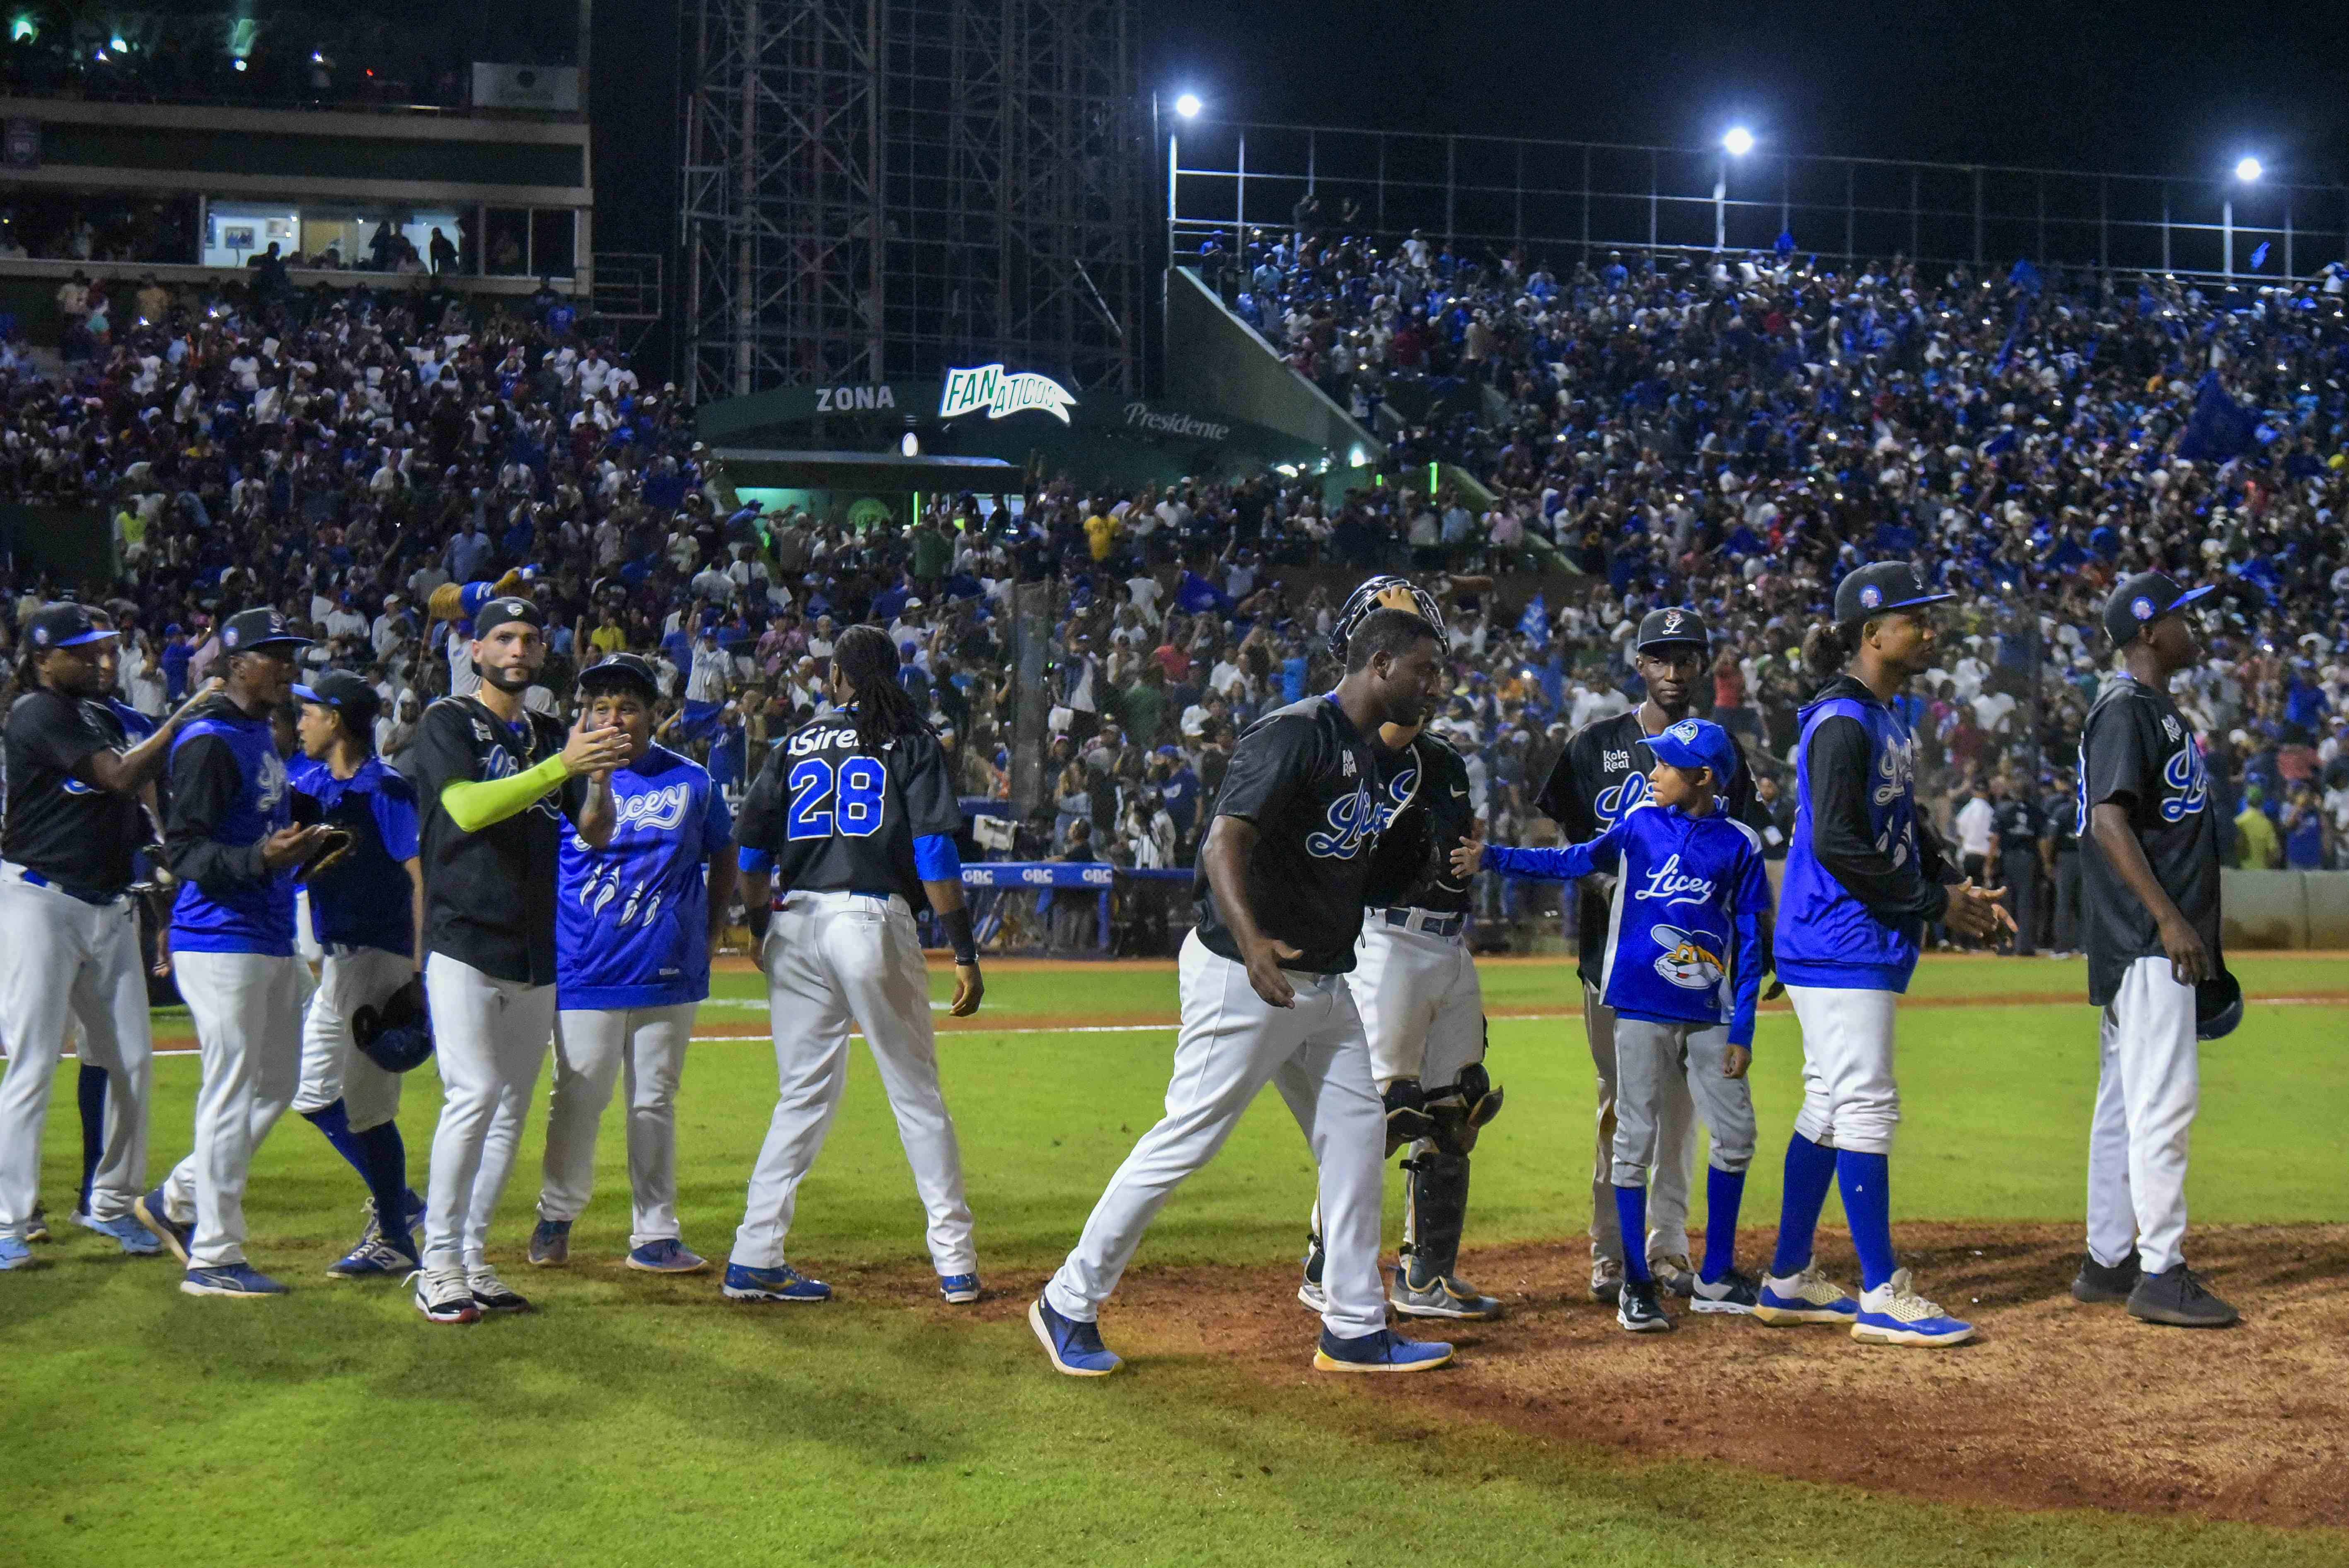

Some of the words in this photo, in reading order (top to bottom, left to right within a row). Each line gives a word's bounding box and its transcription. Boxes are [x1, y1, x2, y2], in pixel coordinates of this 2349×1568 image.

[815, 385, 895, 411] ZONA
[1123, 402, 1230, 440] Presidente
[788, 726, 895, 756] Sire
[1603, 750, 1630, 763] Kola
[1604, 759, 1629, 772] Real
[788, 756, 887, 842] 28
[1635, 853, 1718, 907] Licey
